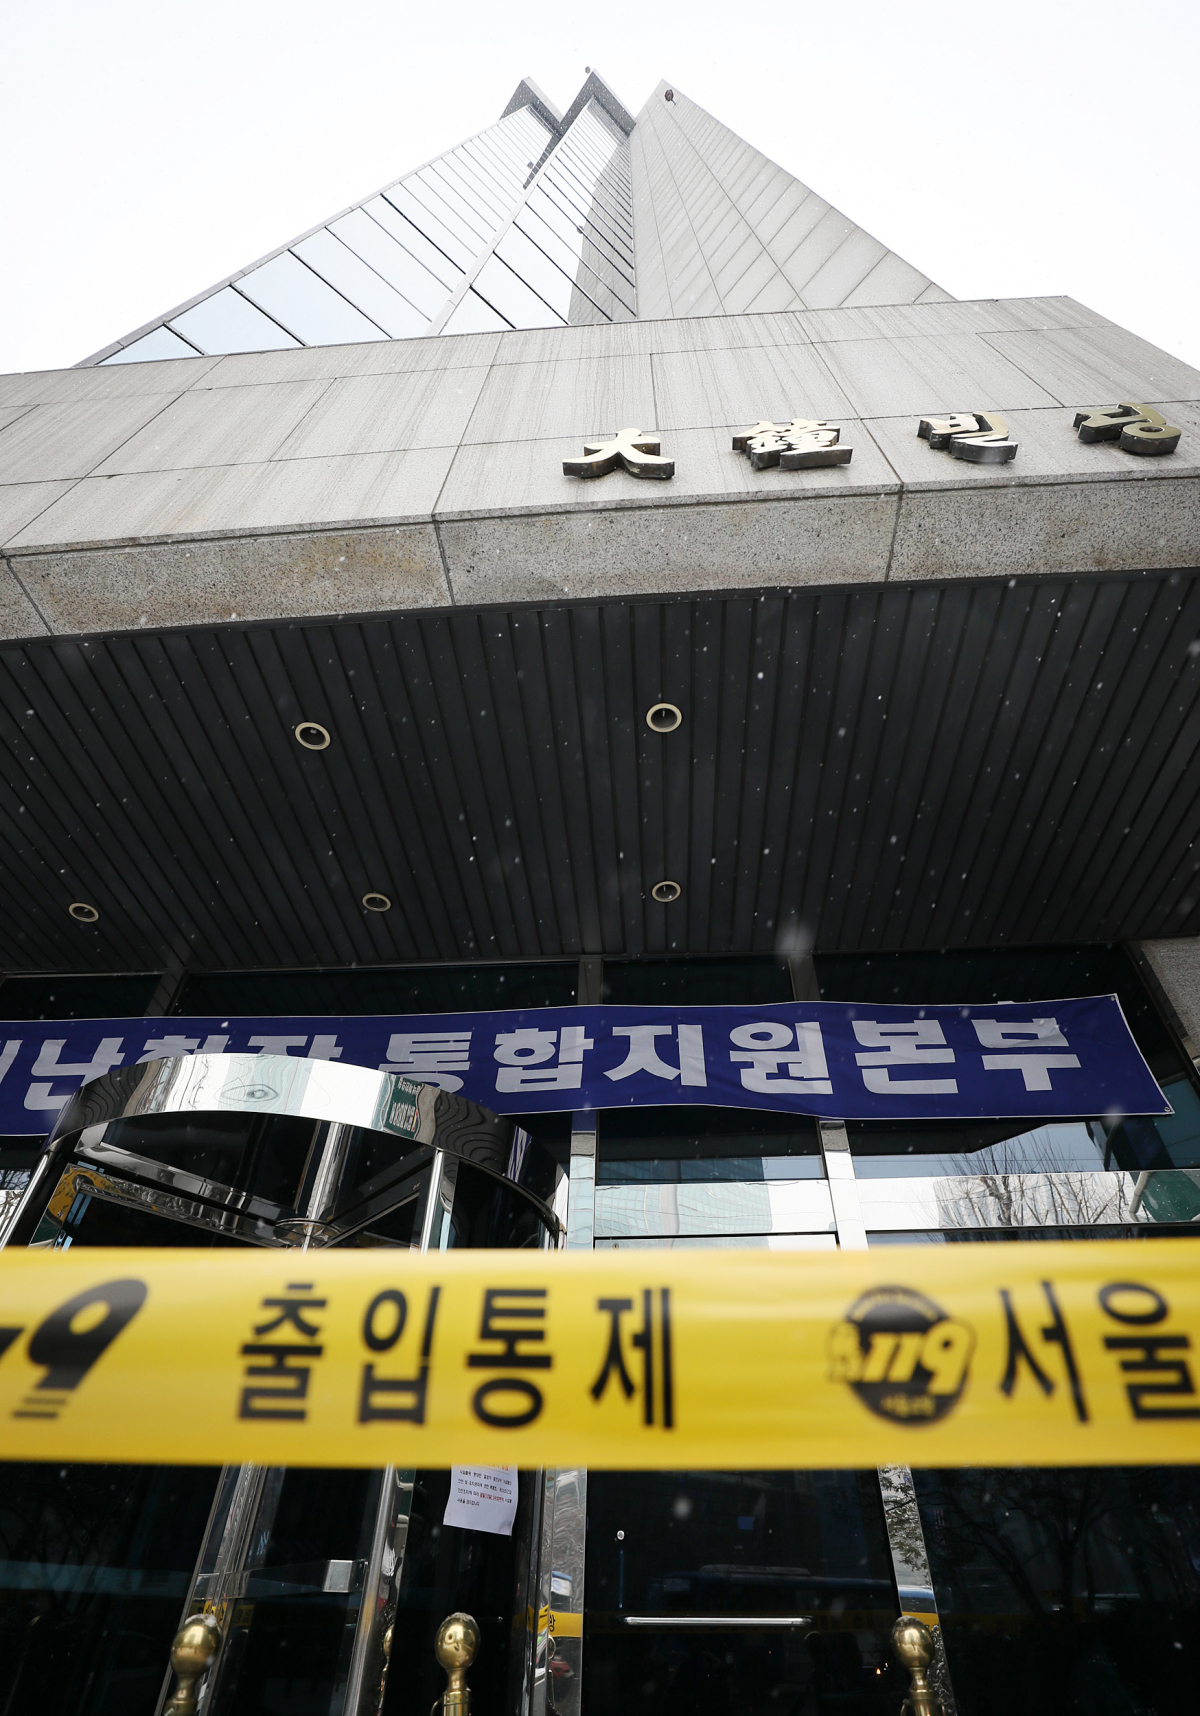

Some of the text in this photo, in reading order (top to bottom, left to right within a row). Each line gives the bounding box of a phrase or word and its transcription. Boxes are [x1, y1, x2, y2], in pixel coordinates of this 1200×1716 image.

[378, 1016, 1082, 1095] 통합지원본부
[237, 1283, 675, 1430] 출입통제
[860, 1320, 974, 1396] 119
[998, 1280, 1200, 1424] 서울
